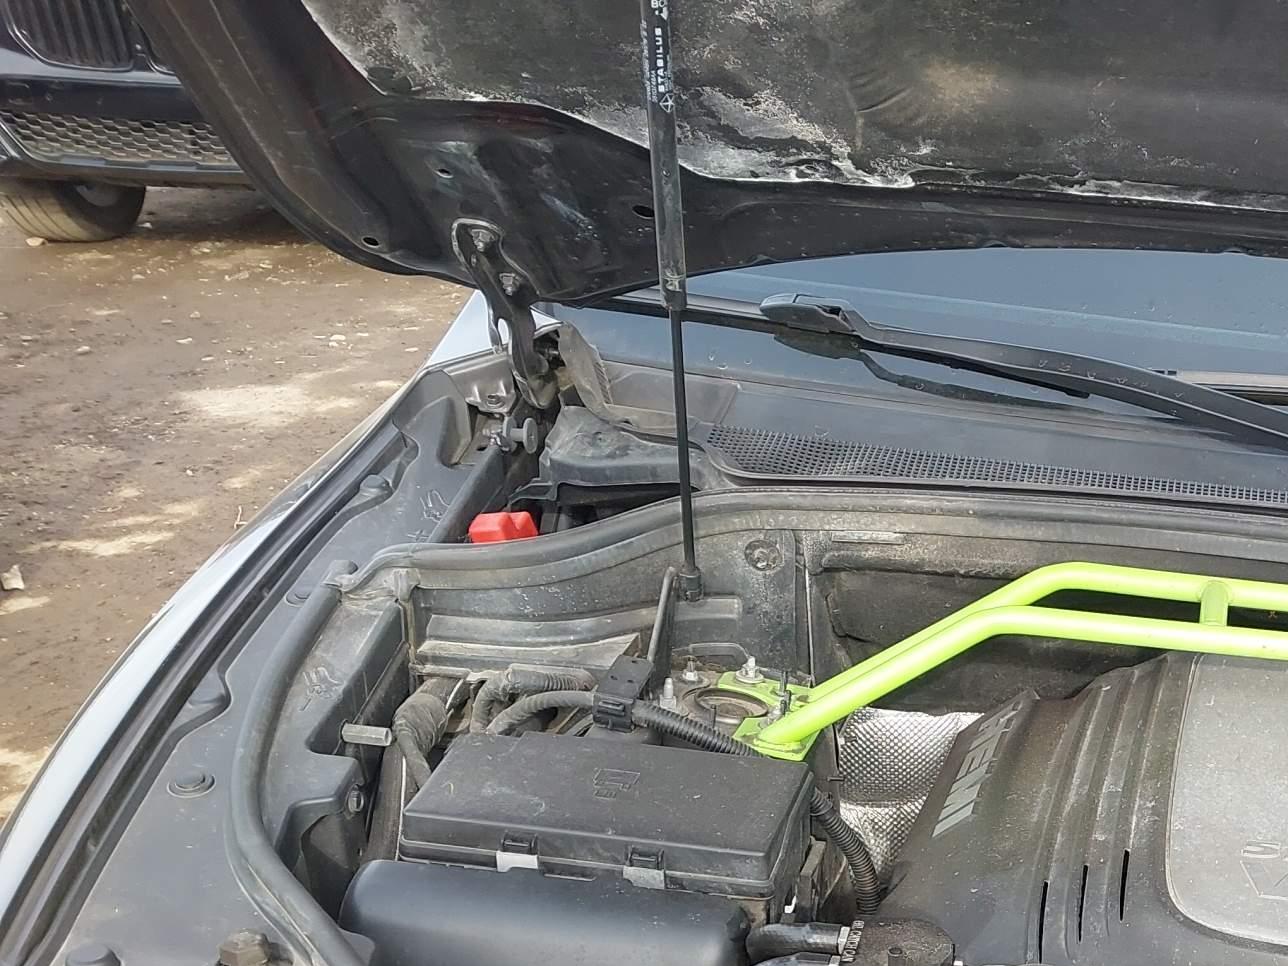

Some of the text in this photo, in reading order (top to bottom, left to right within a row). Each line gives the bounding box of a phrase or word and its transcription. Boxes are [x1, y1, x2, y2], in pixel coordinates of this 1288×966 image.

[655, 27, 665, 92] STABILUS
[931, 702, 1019, 838] HEMI
[841, 948, 857, 962] CAN
[845, 930, 862, 947] CATCH
